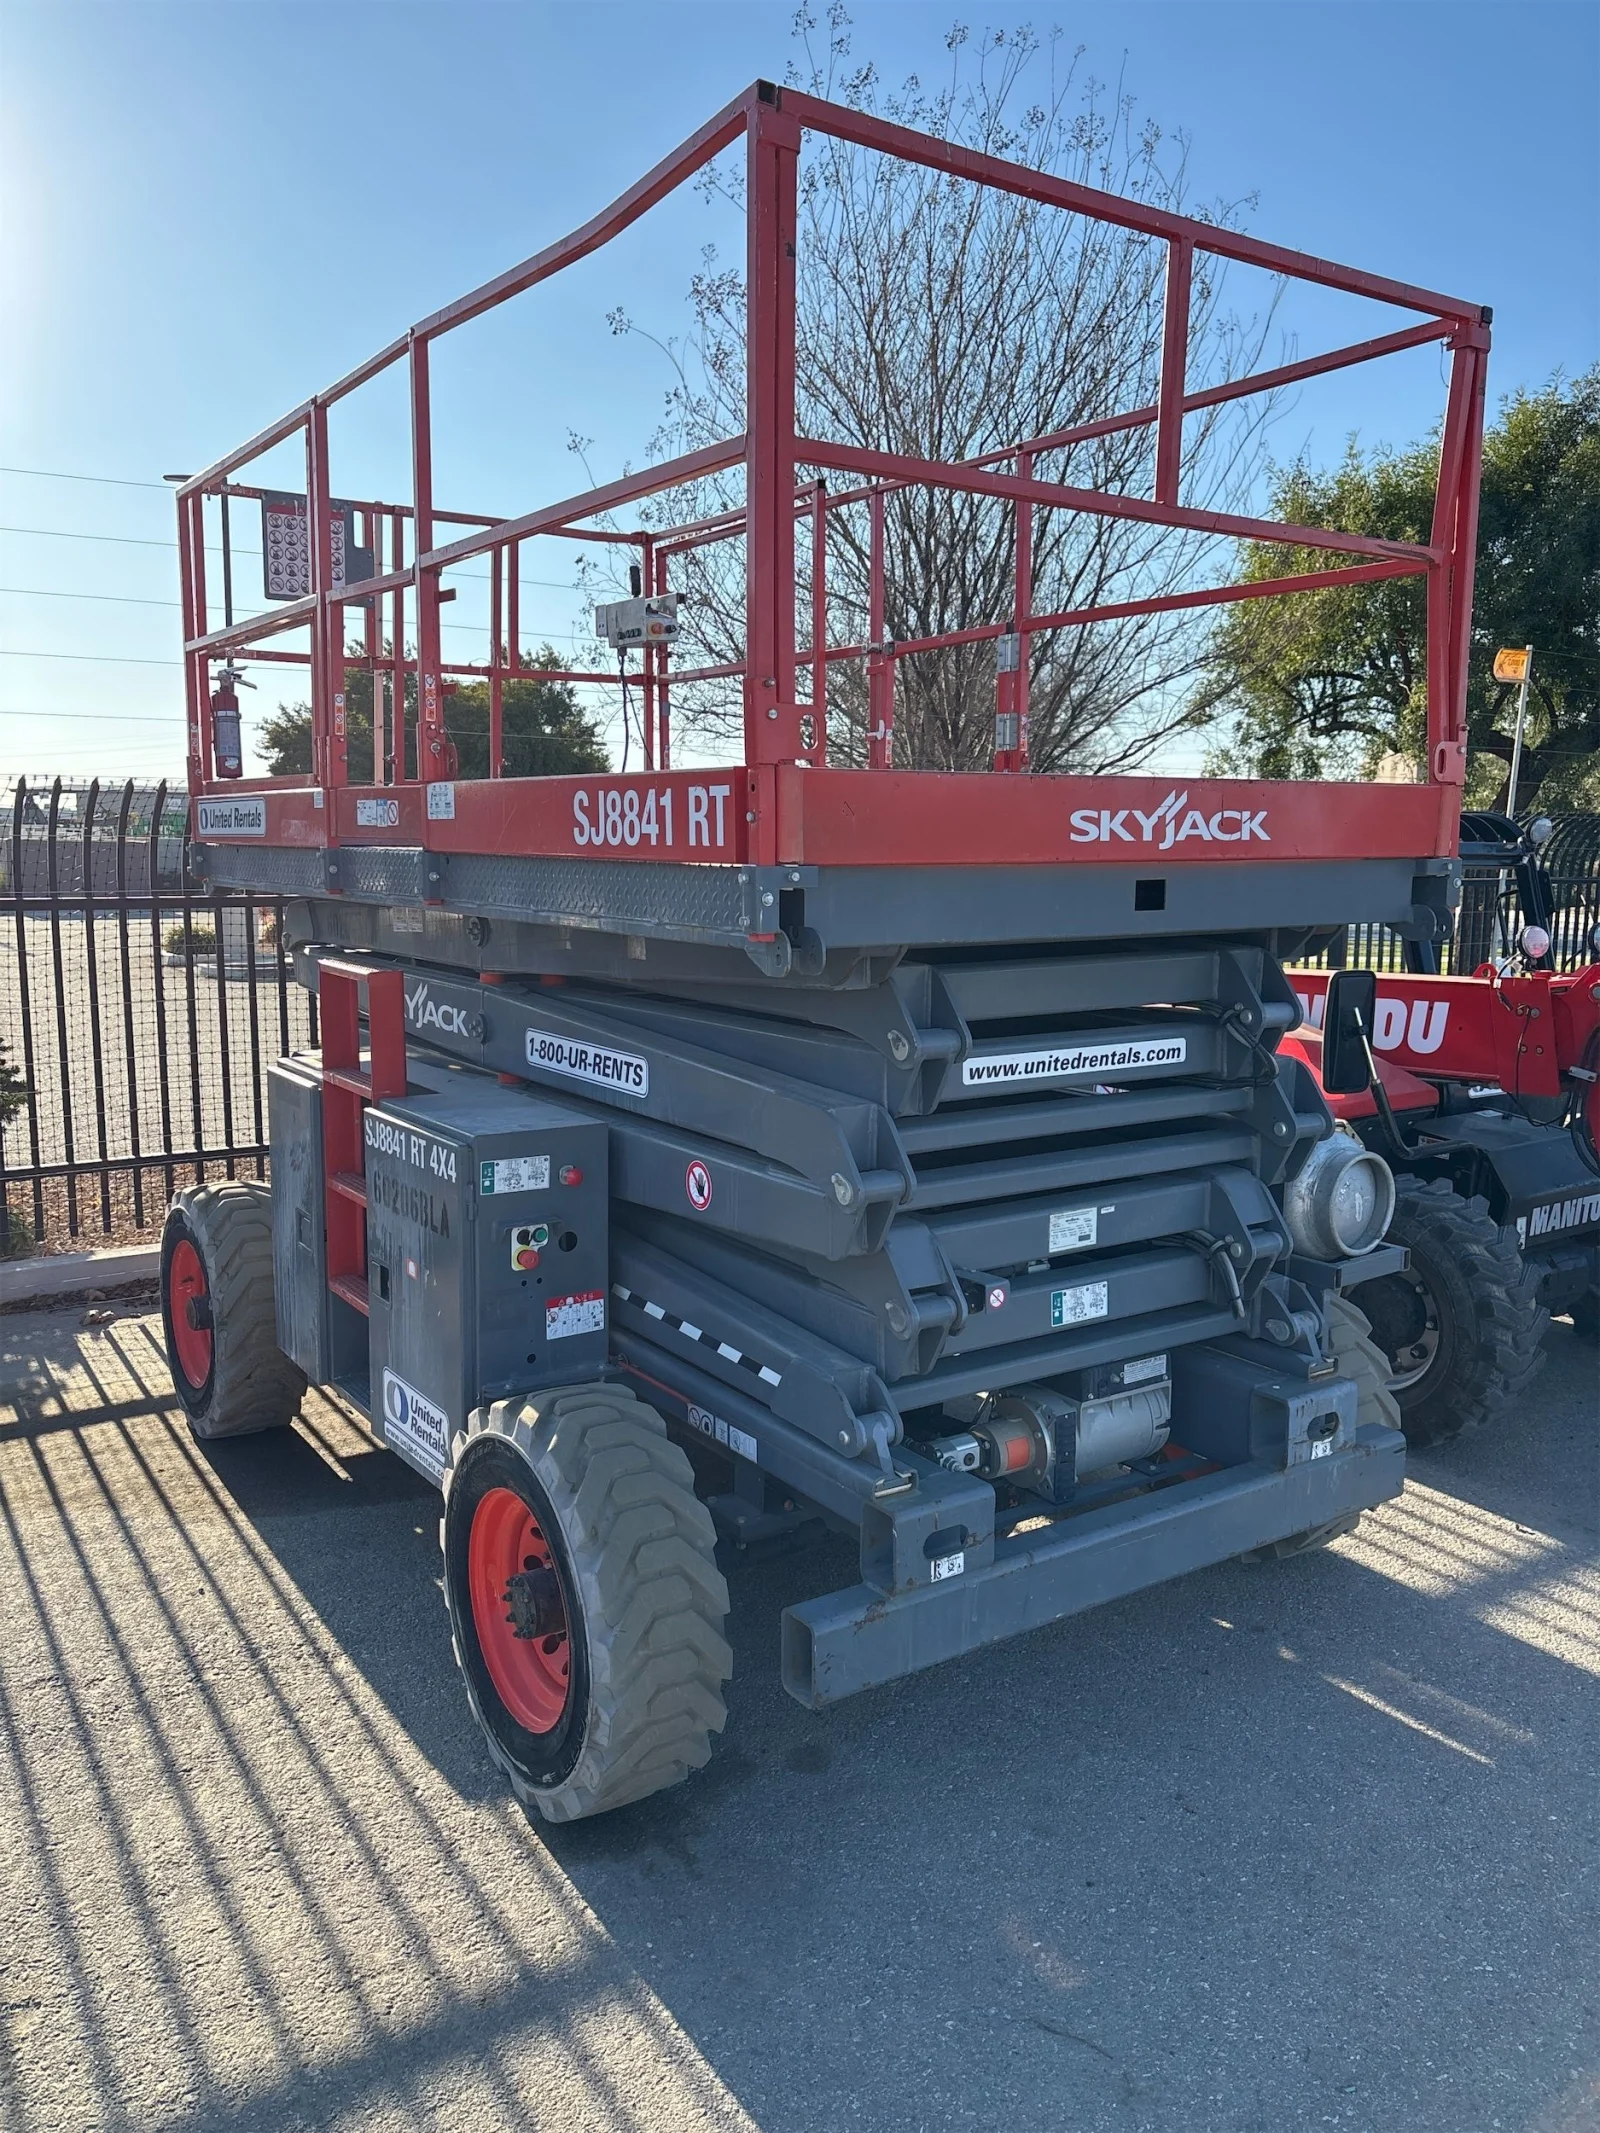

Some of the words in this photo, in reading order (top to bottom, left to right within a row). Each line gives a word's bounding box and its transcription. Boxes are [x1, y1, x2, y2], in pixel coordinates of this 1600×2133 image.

[209, 807, 232, 828] United
[234, 806, 262, 828] Rentals
[573, 788, 672, 846] SJ8841
[688, 785, 730, 846] RT
[1069, 789, 1271, 850] SKYJACK
[404, 982, 469, 1037] YJACK
[529, 1037, 644, 1087] 1-800-UR-RENTS
[969, 1046, 1182, 1081] www.unitedrentals.com
[365, 1118, 406, 1160] SJ8841
[410, 1134, 427, 1169] RT
[430, 1144, 457, 1183] 4X4
[410, 1396, 442, 1433] United
[410, 1416, 446, 1456] Rentals
[385, 1426, 445, 1480] www.unitedrentals.co
